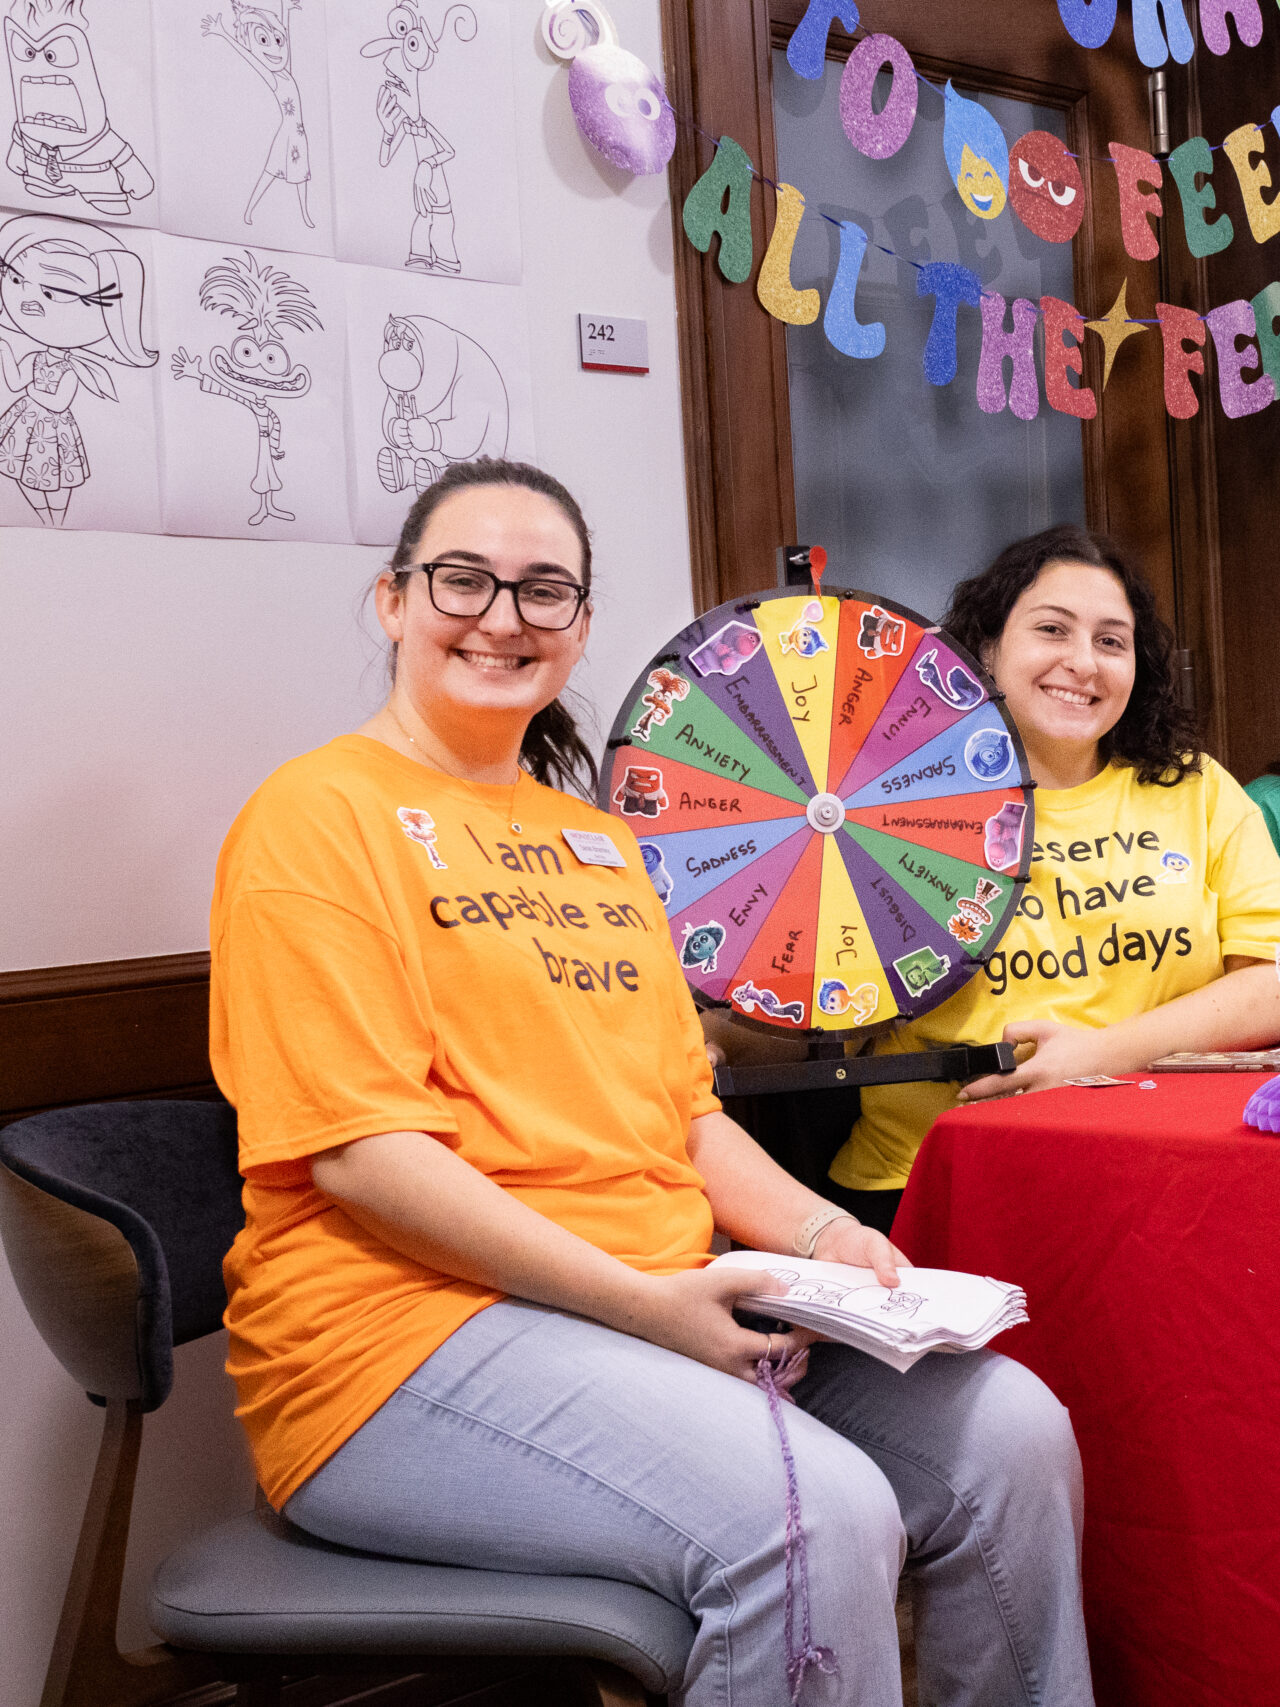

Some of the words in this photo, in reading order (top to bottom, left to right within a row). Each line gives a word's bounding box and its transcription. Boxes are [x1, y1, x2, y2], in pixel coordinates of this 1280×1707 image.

[682, 136, 886, 360] ALL
[917, 261, 1098, 420] THE
[587, 322, 615, 341] 242
[791, 675, 818, 723] JOY
[838, 668, 873, 726] ANGER
[882, 696, 932, 740] ENNUI
[675, 724, 752, 781] ANXIETY
[725, 675, 808, 786] EMBARRASSMENT
[881, 755, 957, 794] SADNESS
[679, 792, 742, 813] ANGER
[464, 823, 494, 865] I
[496, 842, 564, 875] am
[685, 839, 757, 877] SADNESS
[1032, 830, 1160, 862] eserve
[898, 852, 959, 901] ANXIETY
[1014, 895, 1044, 920] o
[1056, 875, 1156, 919] have
[429, 886, 590, 930] capable
[729, 883, 769, 927] ENVY
[870, 877, 917, 942] DISGUST
[532, 937, 640, 993] brave
[772, 929, 803, 975] FEAR
[836, 924, 858, 966] JOY
[983, 934, 1088, 994] good
[1098, 923, 1192, 972] days
